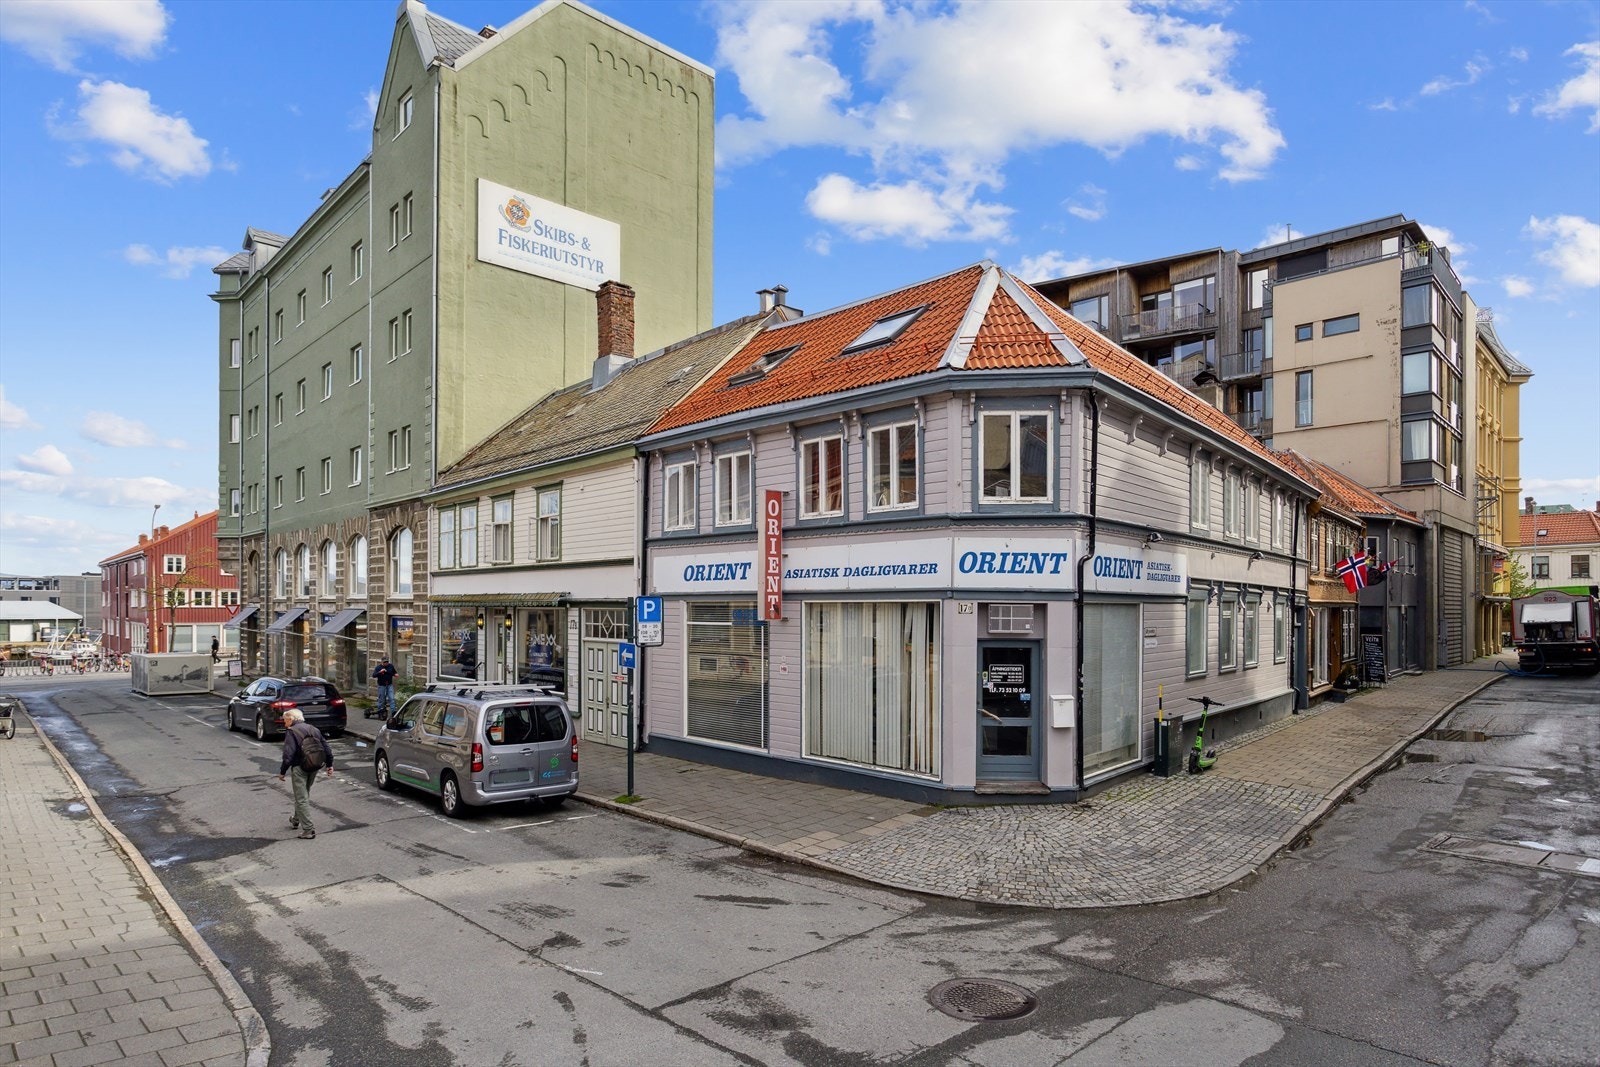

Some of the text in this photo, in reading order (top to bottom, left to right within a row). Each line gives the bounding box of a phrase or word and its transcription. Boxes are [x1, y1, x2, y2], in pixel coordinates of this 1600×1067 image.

[498, 228, 604, 274] FISKERIUTSTYR
[581, 237, 592, 252] &
[767, 499, 780, 611] ORIENT
[958, 551, 1068, 575] ORIENT
[683, 562, 939, 582] ORIENT ASIATISK DAGLIGVARER
[1093, 555, 1144, 580] ORIENT
[1147, 572, 1182, 583] DAGLIGVARER
[643, 600, 656, 620] P
